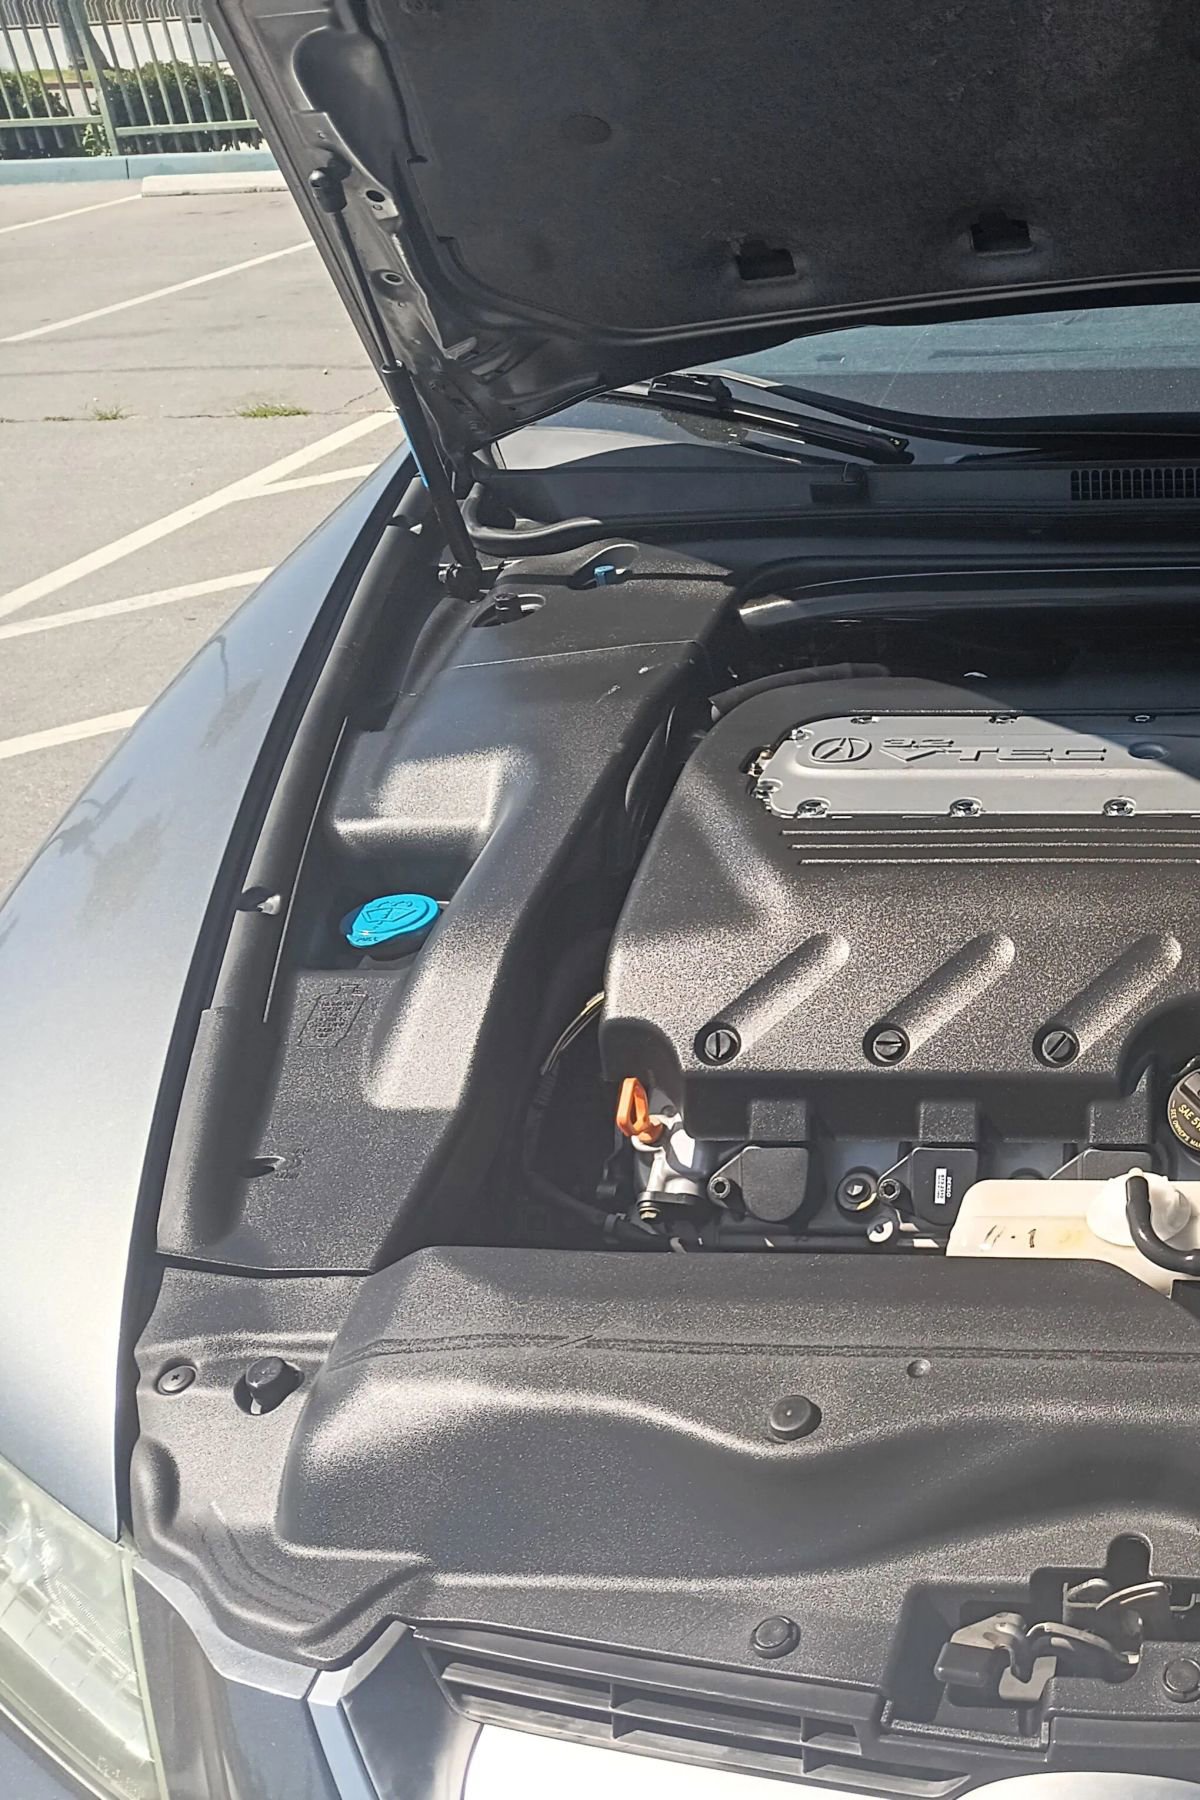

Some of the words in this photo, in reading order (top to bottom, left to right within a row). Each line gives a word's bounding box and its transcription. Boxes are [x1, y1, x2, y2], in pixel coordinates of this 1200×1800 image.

[883, 737, 955, 749] 3.2
[879, 746, 1107, 763] VTEC
[1178, 1104, 1194, 1120] SAE
